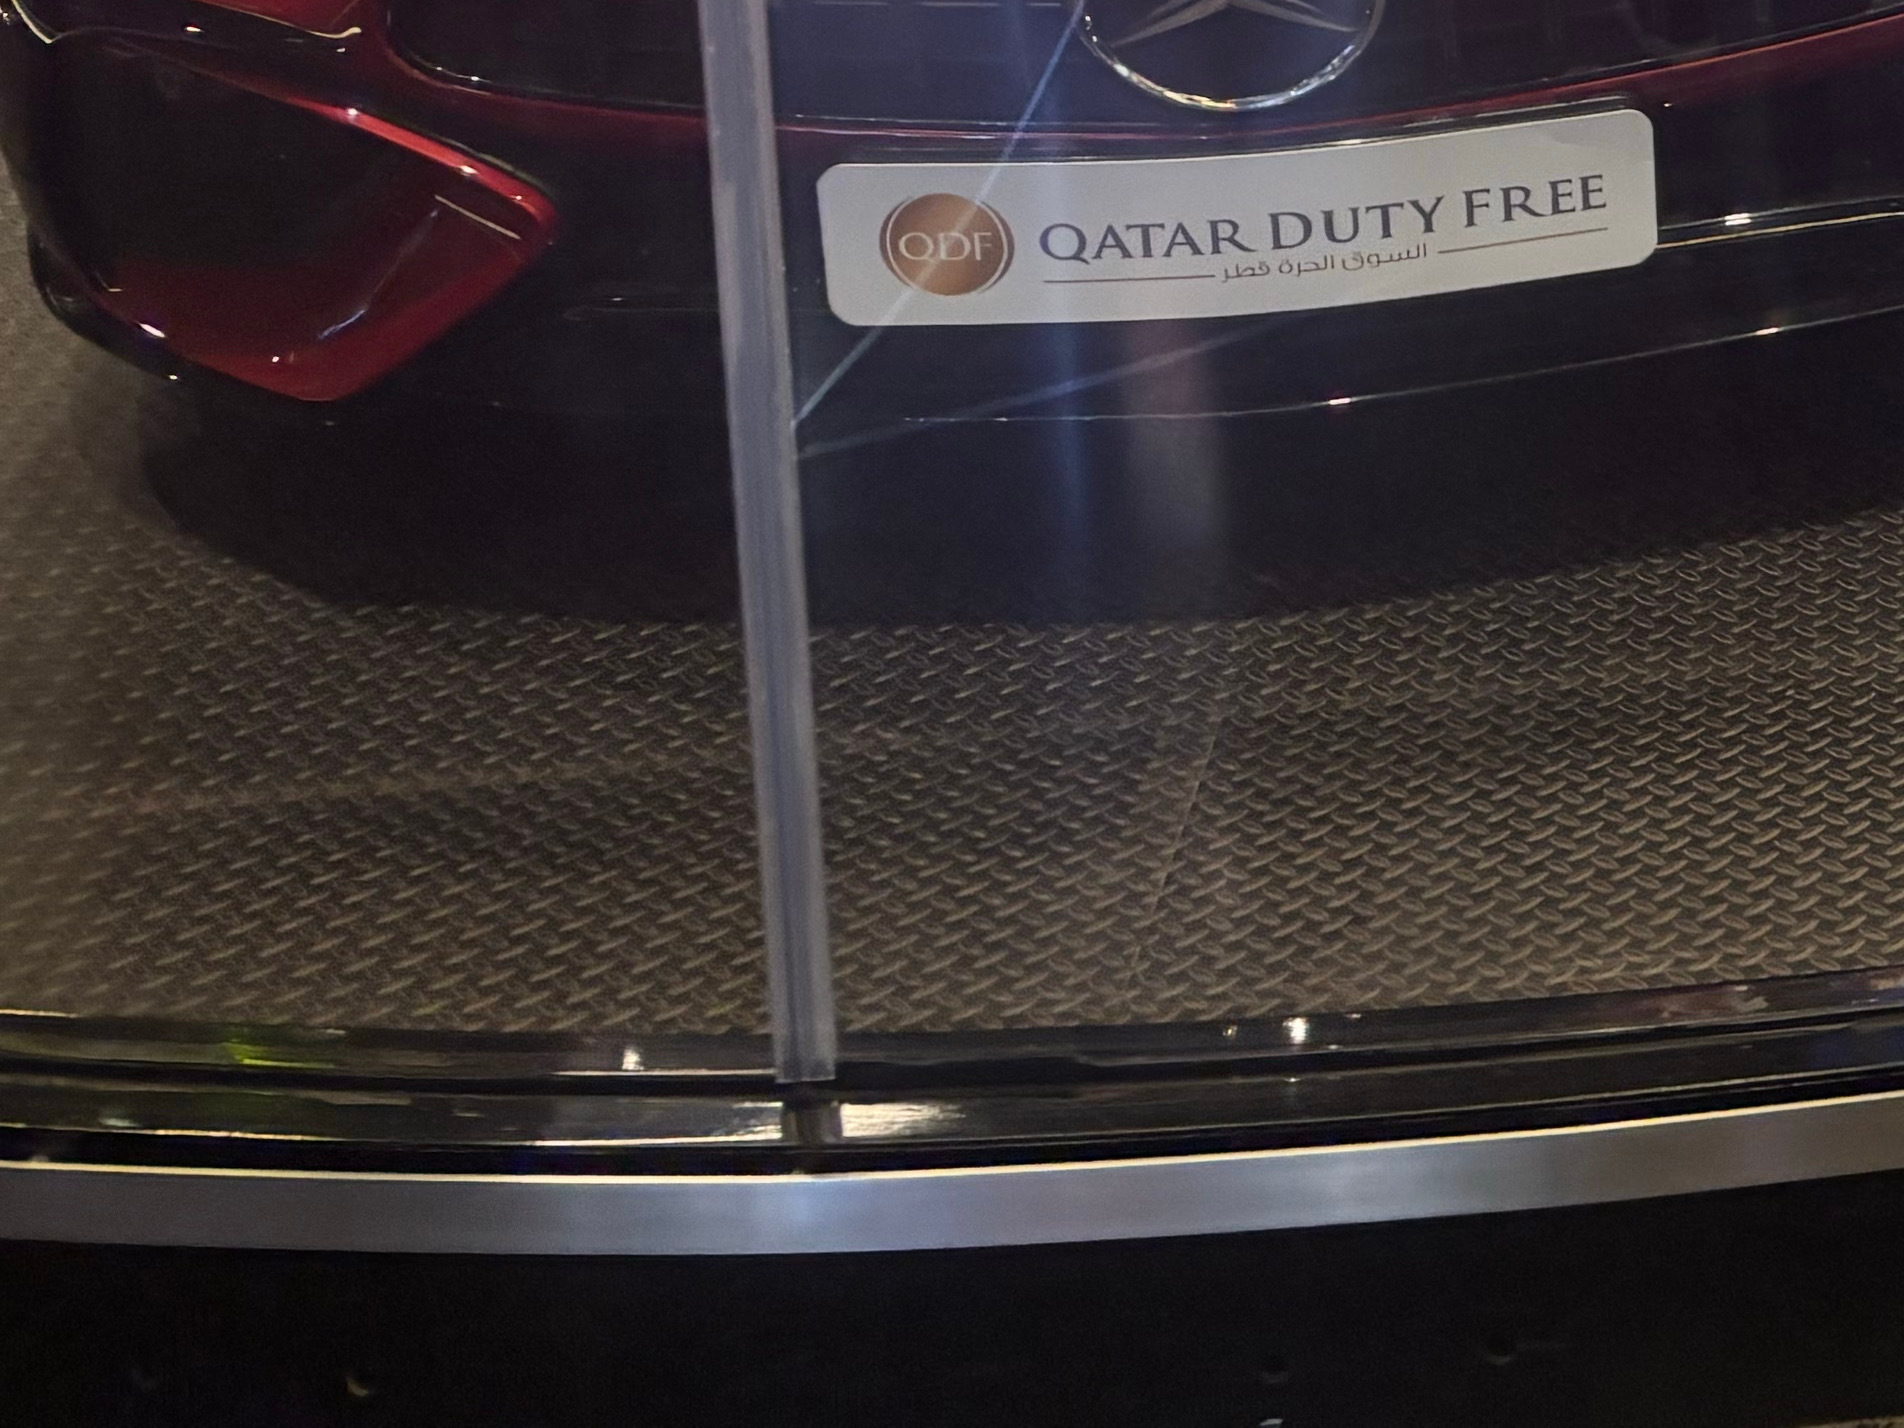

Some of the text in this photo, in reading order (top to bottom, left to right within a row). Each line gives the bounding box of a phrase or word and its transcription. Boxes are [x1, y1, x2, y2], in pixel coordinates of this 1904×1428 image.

[1038, 174, 1608, 265] QATAR DUTY FREE
[899, 231, 993, 262] QDF
[1222, 242, 1427, 283] السوق الحرة قطر
